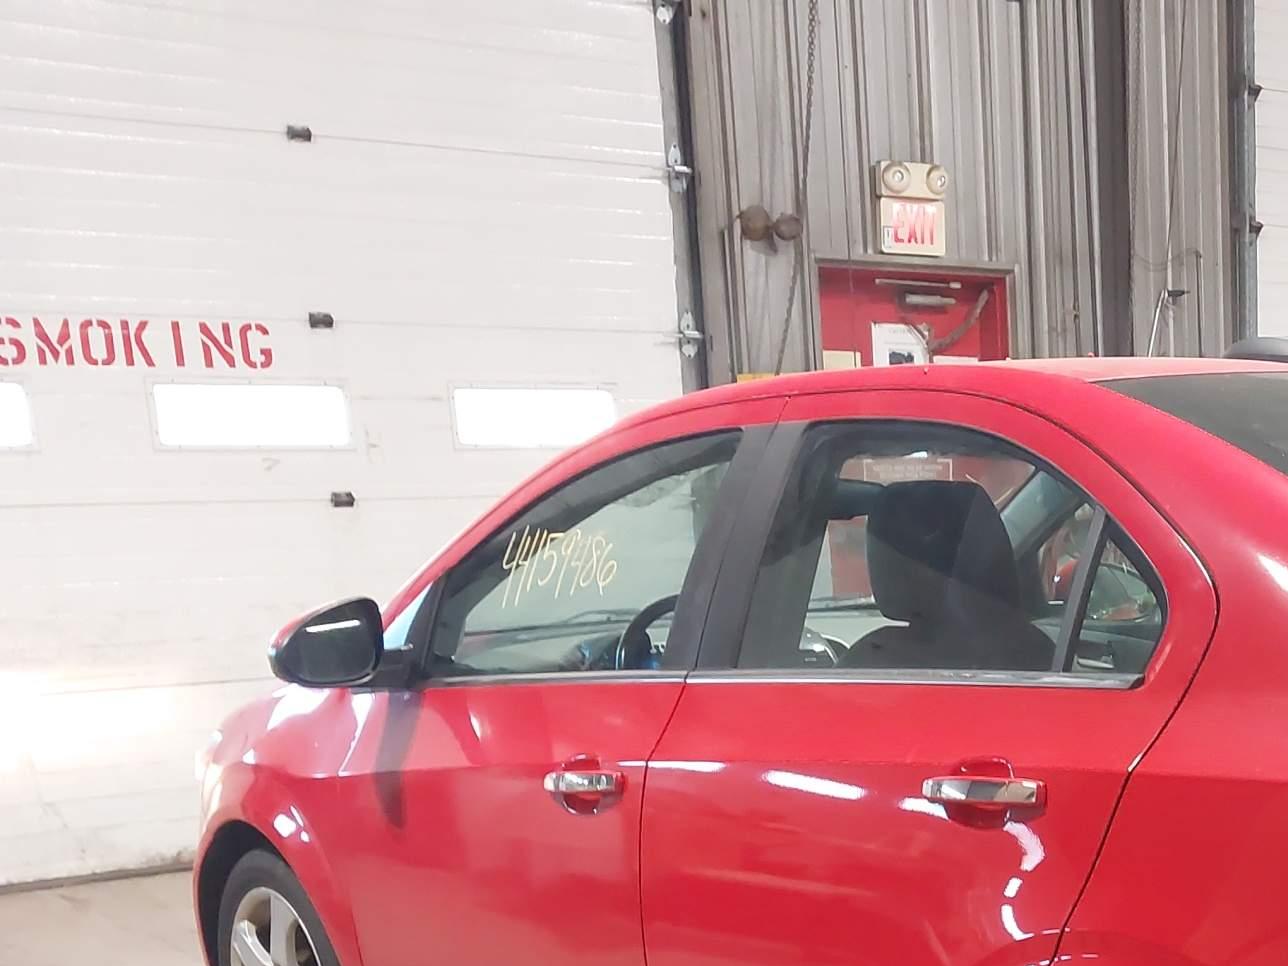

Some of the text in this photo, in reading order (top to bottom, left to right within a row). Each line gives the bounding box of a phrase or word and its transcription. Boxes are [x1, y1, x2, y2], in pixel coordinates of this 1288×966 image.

[893, 203, 936, 246] EXIT
[0, 316, 273, 369] SMOKING
[502, 524, 617, 609] 44159486
